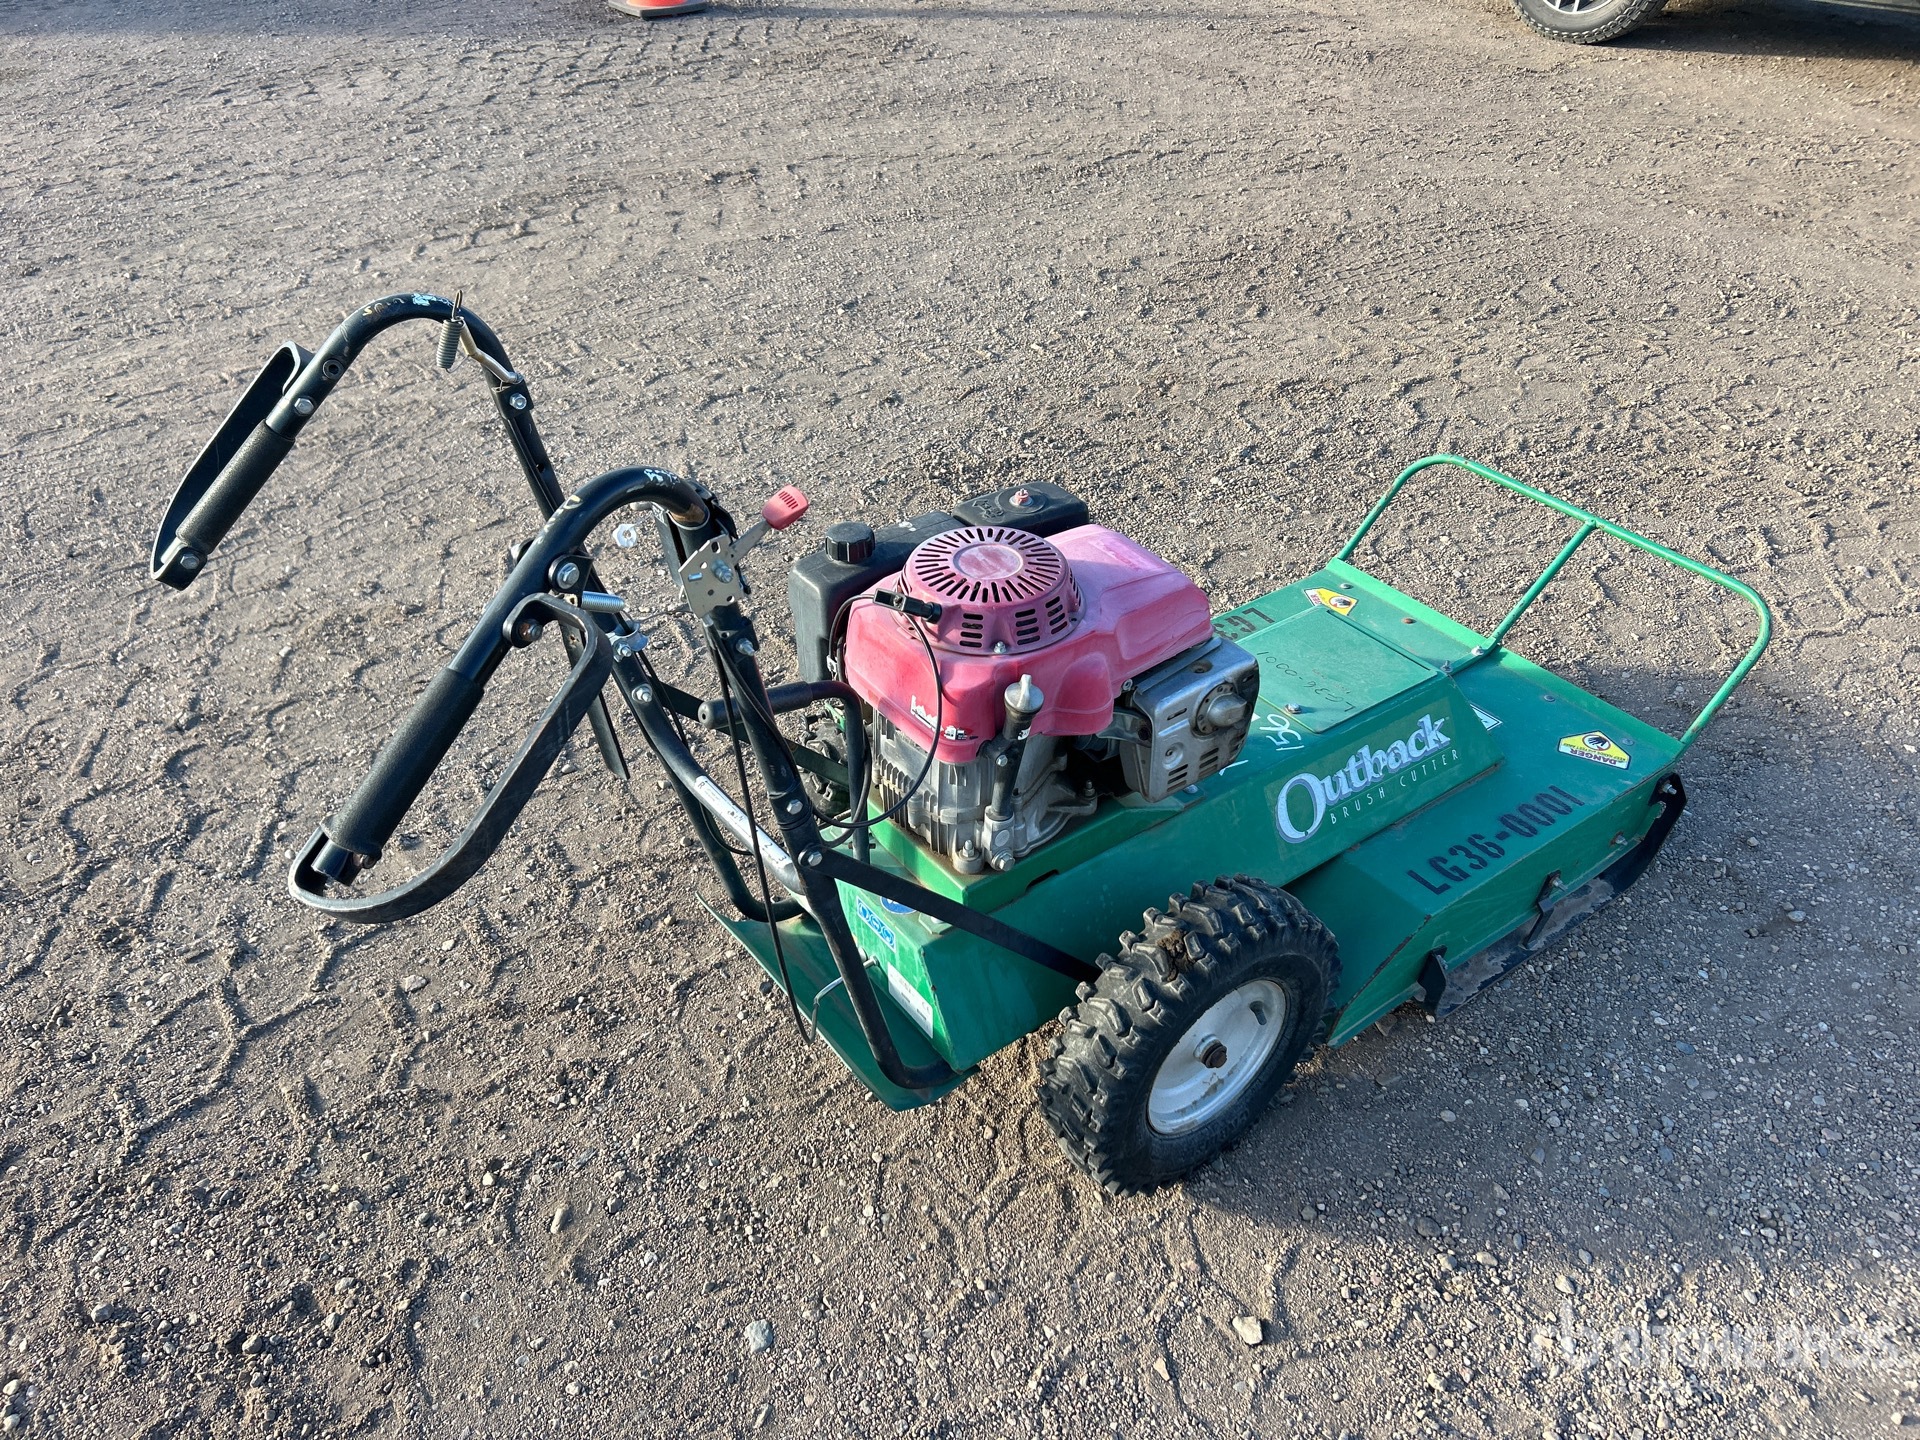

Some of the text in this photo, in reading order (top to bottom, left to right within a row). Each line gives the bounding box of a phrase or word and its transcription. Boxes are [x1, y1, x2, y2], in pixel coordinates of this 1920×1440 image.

[1274, 712, 1451, 844] Outback
[1329, 748, 1460, 825] BRUSH CUTTER
[1570, 748, 1617, 765] DANGER
[1406, 784, 1586, 896] LG36-0001
